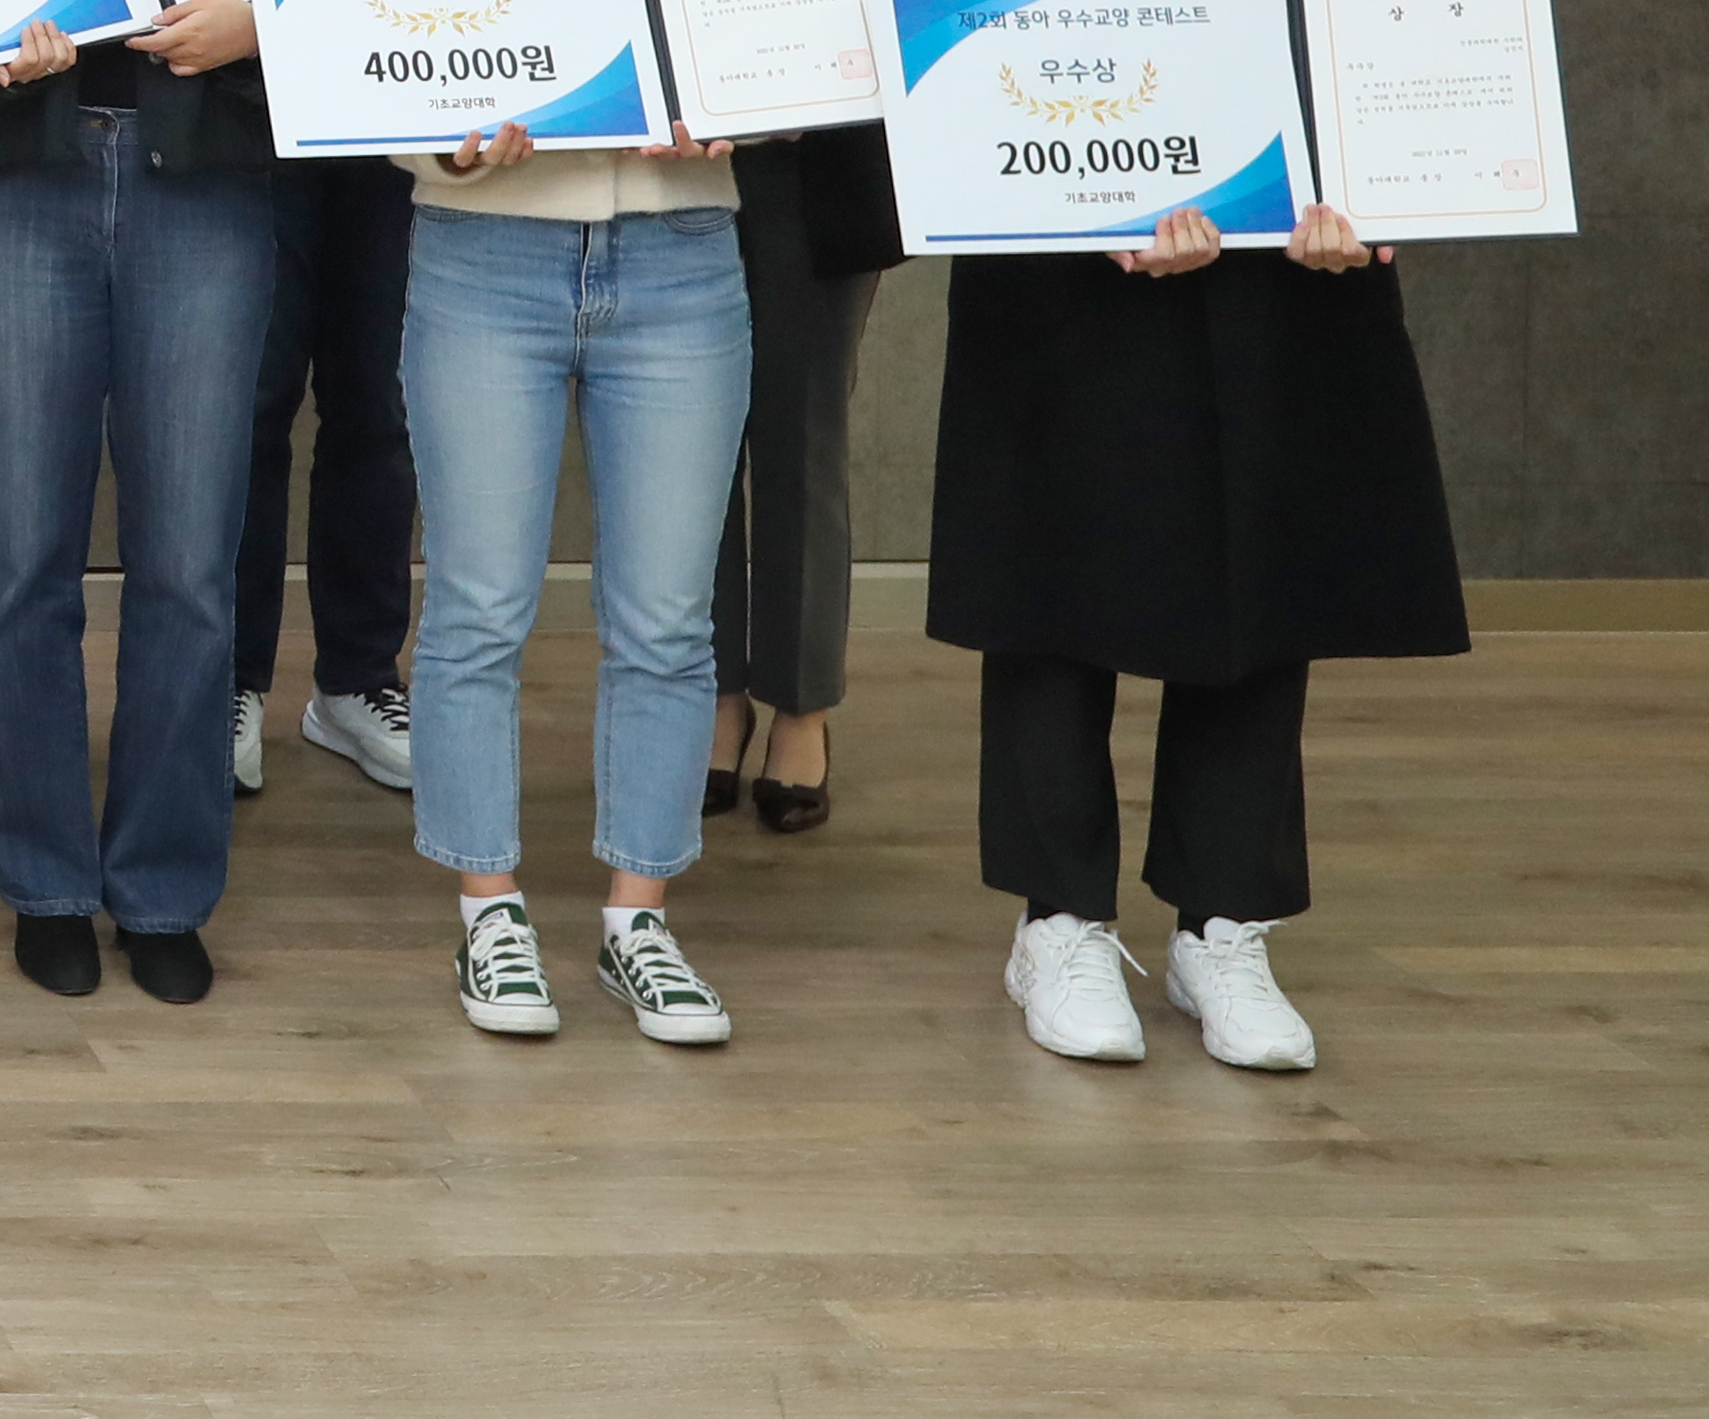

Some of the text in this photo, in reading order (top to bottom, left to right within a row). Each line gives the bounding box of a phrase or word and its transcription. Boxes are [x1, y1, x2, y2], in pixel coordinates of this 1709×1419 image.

[957, 6, 1211, 31] 제2회 동아 우수교양 콘테스트
[363, 44, 558, 88] 400,000원
[1039, 57, 1117, 85] 우수상
[428, 96, 496, 110] 기초교양대학
[996, 135, 1202, 181] 200,000원
[1065, 190, 1136, 204] 기초교양대학
